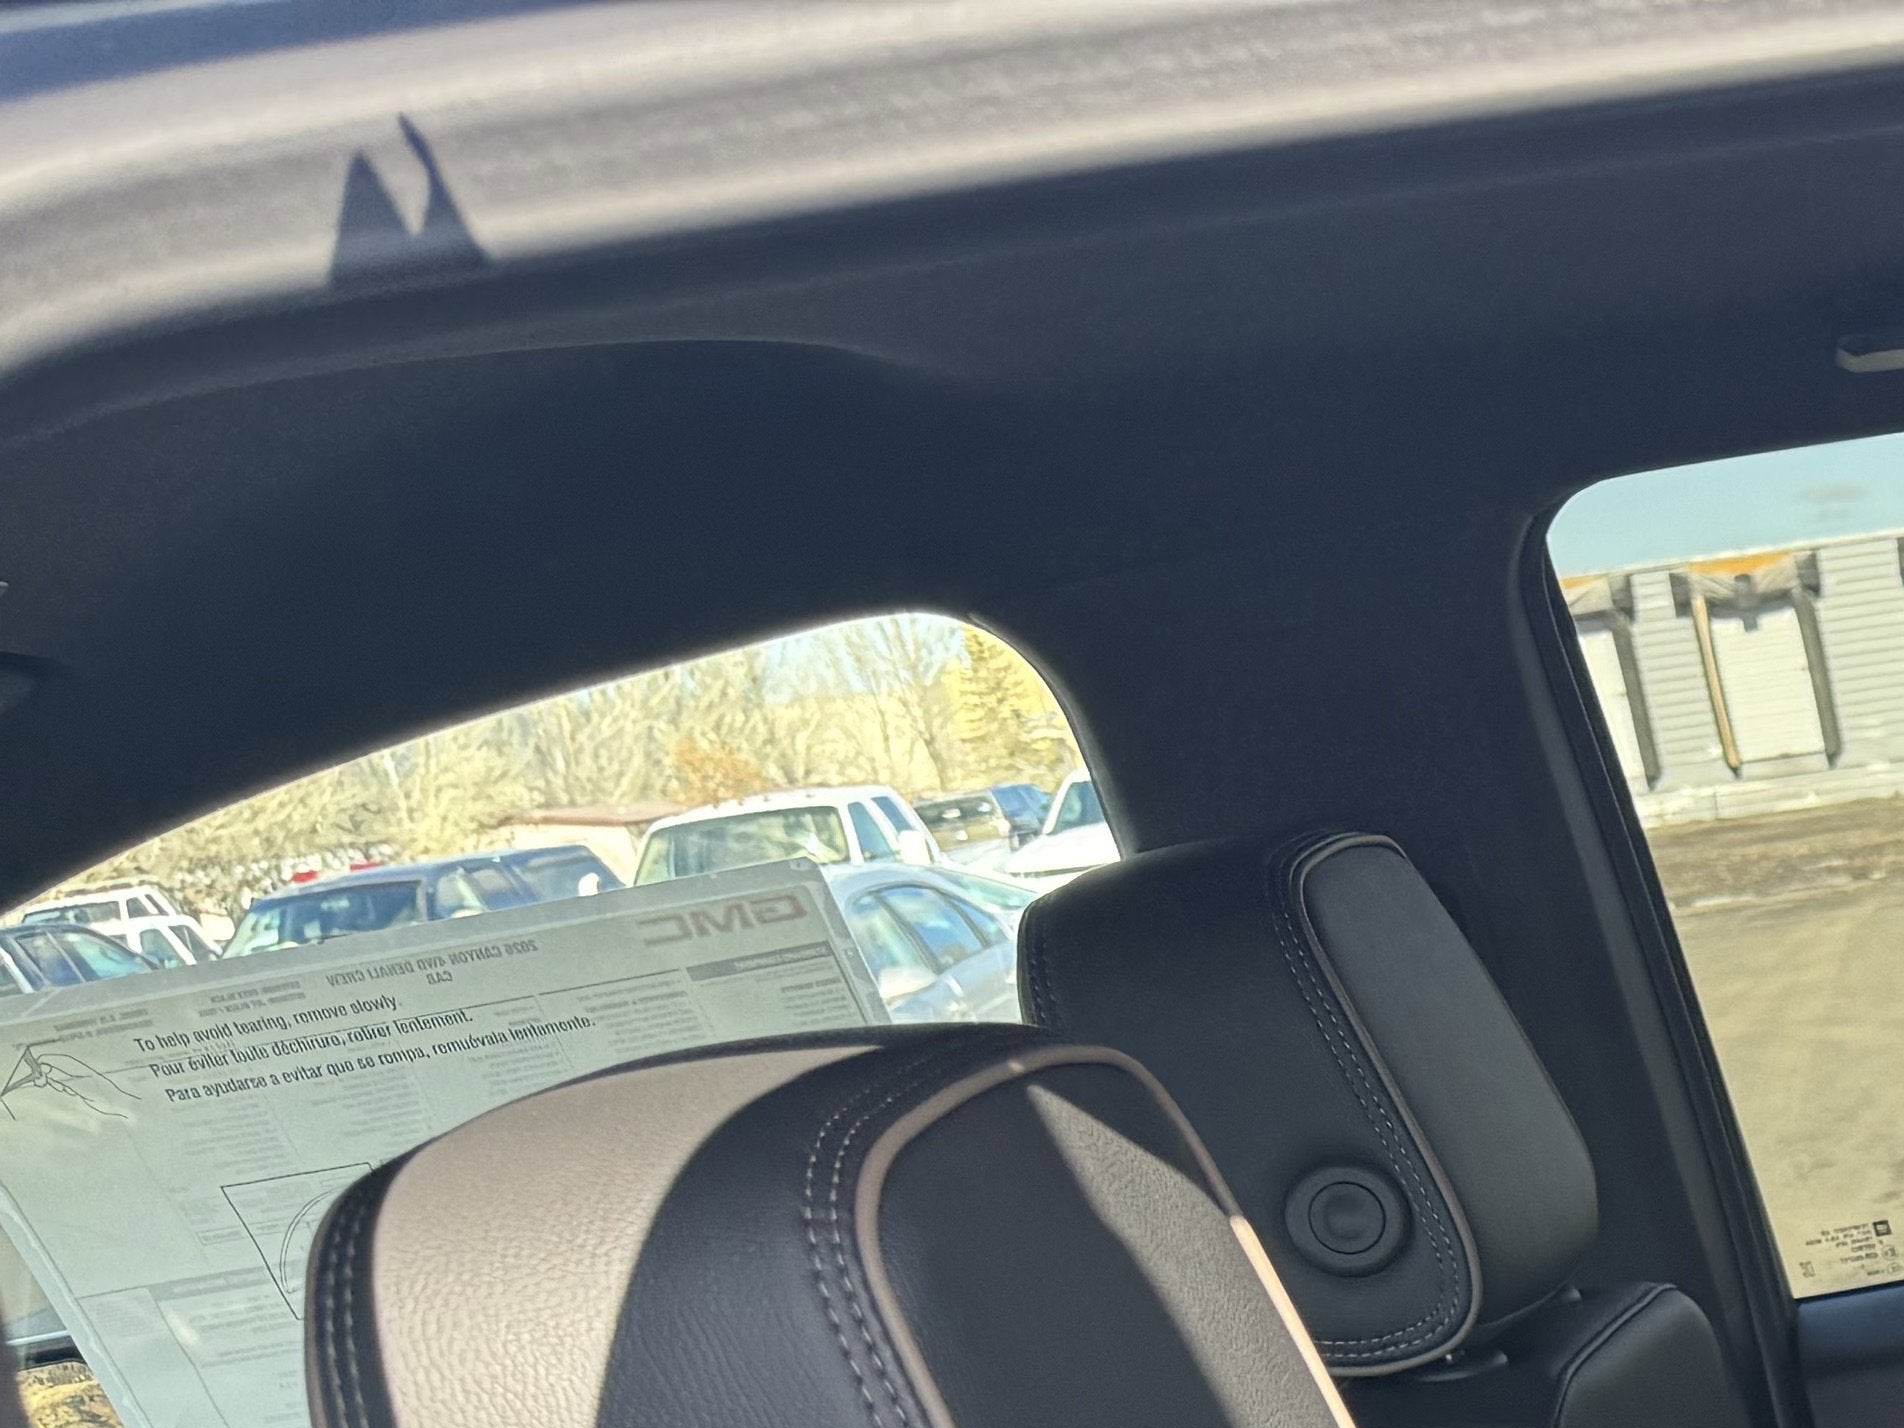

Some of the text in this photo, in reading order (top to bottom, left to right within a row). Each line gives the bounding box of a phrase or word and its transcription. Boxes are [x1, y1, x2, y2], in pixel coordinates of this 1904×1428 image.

[132, 1038, 156, 1053] To
[157, 1031, 191, 1051] help
[192, 1022, 234, 1044] avoid
[233, 1013, 293, 1037] tearing,
[292, 1002, 348, 1026] remove
[149, 1061, 186, 1078] Pour
[230, 1044, 270, 1064] toute
[347, 1025, 392, 1044] retirer
[393, 1008, 473, 1036] lentement.
[164, 1015, 597, 1103] Para ayudarse a evitar que se rompa, remuévala lentamente.
